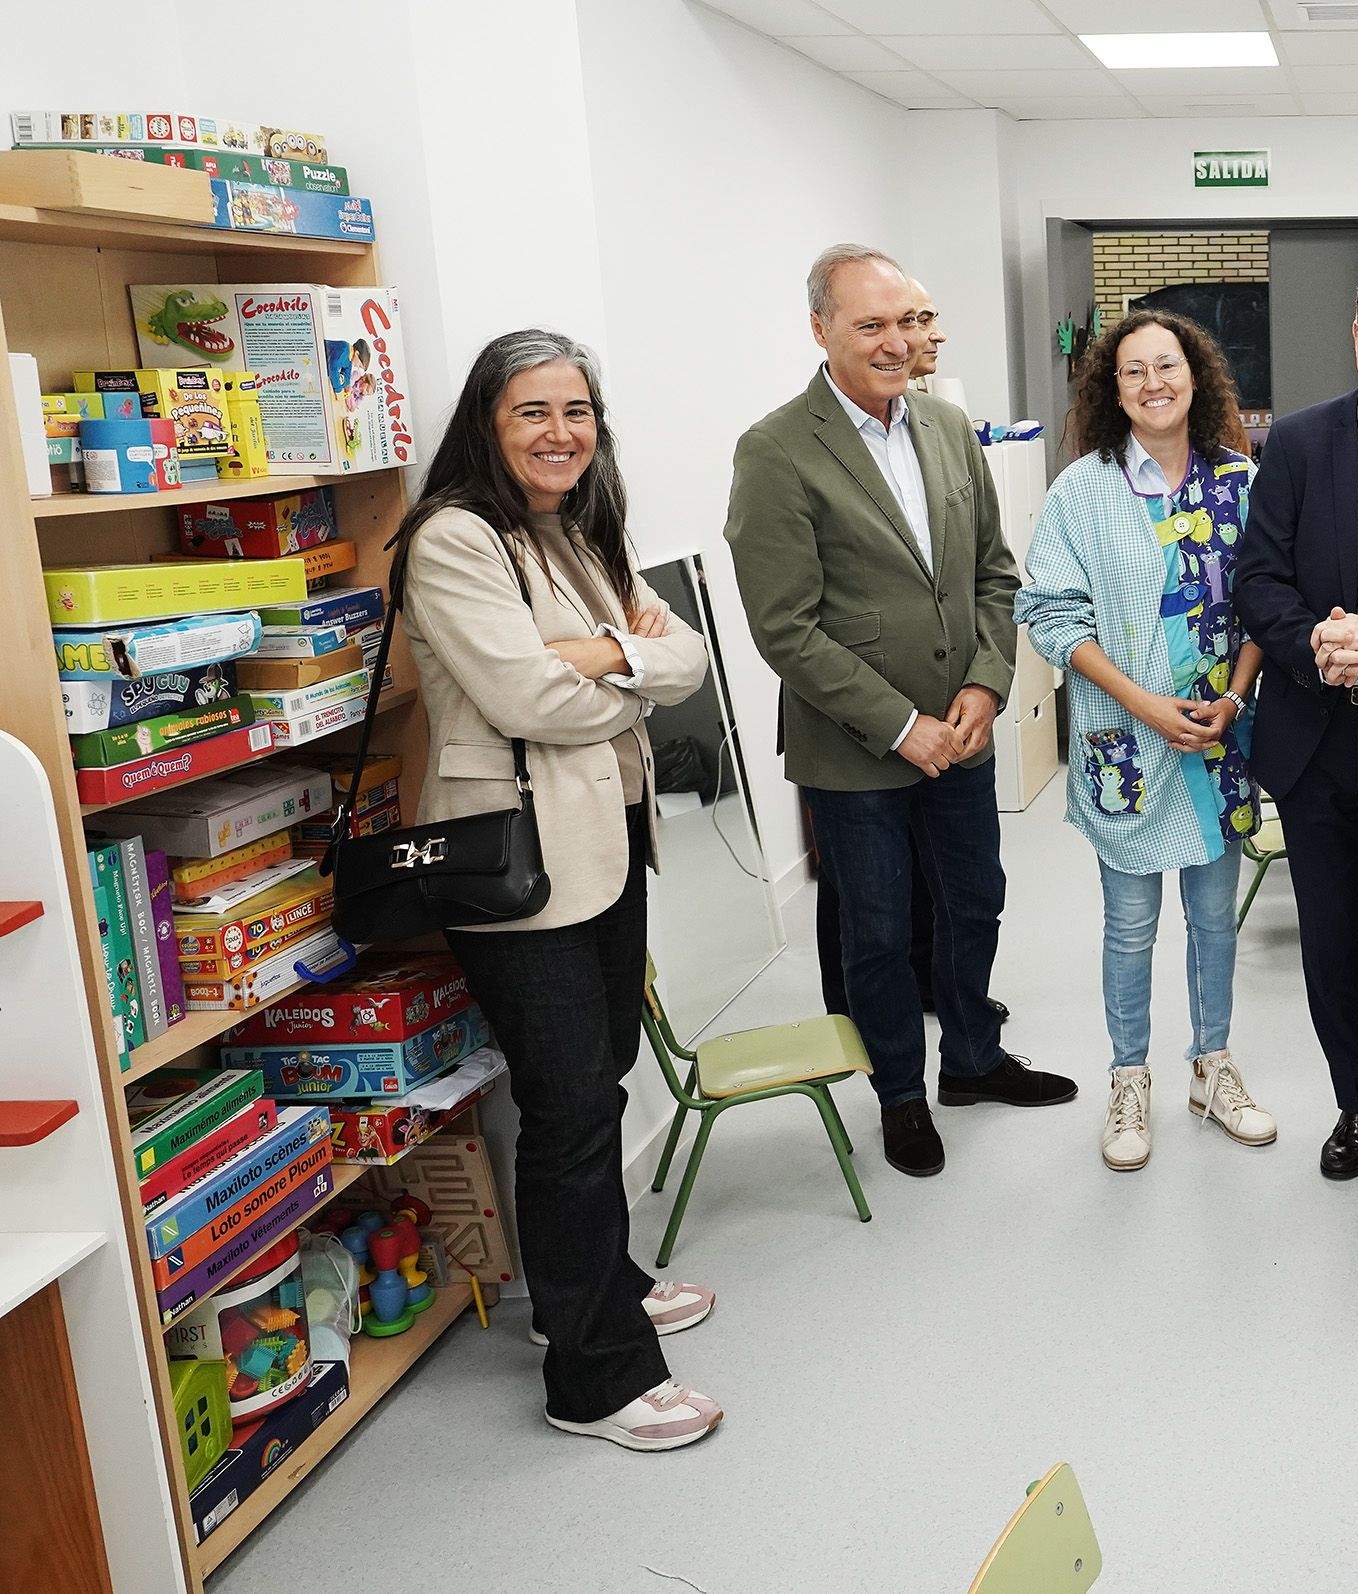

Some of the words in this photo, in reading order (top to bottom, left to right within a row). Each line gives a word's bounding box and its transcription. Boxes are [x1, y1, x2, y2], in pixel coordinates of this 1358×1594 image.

[303, 166, 336, 181] Puzzle
[1196, 160, 1267, 180] SALIDA
[241, 296, 308, 319] Cocodrilo
[360, 298, 412, 463] Cocodrilo
[194, 392, 207, 400] Los
[171, 401, 223, 421] Pequeñines
[321, 615, 344, 626] Answer
[345, 609, 368, 621] Buzzers
[57, 644, 111, 672] ME
[120, 675, 156, 706] SPY
[156, 673, 190, 692] GUY
[310, 690, 323, 699] Mundo
[315, 721, 325, 730] DEL
[325, 713, 347, 727] ALFABETO
[321, 706, 344, 719] TRENECITO
[122, 767, 151, 788] Quem
[156, 753, 192, 778] Quem?
[112, 870, 121, 904] Magneto
[118, 922, 127, 936] Up!
[289, 903, 313, 921] LINCE
[126, 842, 144, 907] MAGNETISK
[136, 911, 148, 934] BOG
[142, 946, 157, 995] MAGNETIC
[150, 999, 161, 1026] BOOK
[251, 922, 263, 935] 70
[264, 1007, 335, 1028] KALEIDOS
[287, 1021, 313, 1034] Junior
[281, 1056, 297, 1066] TIC
[312, 1055, 330, 1065] TAC
[182, 1168, 193, 1180] Le
[193, 1155, 216, 1178] temps
[228, 1134, 249, 1154] passe
[205, 1163, 263, 1213] Maxiloto
[264, 1131, 307, 1172] scènes
[144, 1195, 166, 1212] Nathan
[210, 1211, 242, 1242] Loto
[244, 1177, 287, 1217] sonore
[288, 1145, 327, 1182] Ploum
[207, 1241, 250, 1279] Maxiloto
[251, 1201, 300, 1243] Vêtements
[169, 1295, 194, 1317] Nathan
[169, 1325, 207, 1343] IRST
